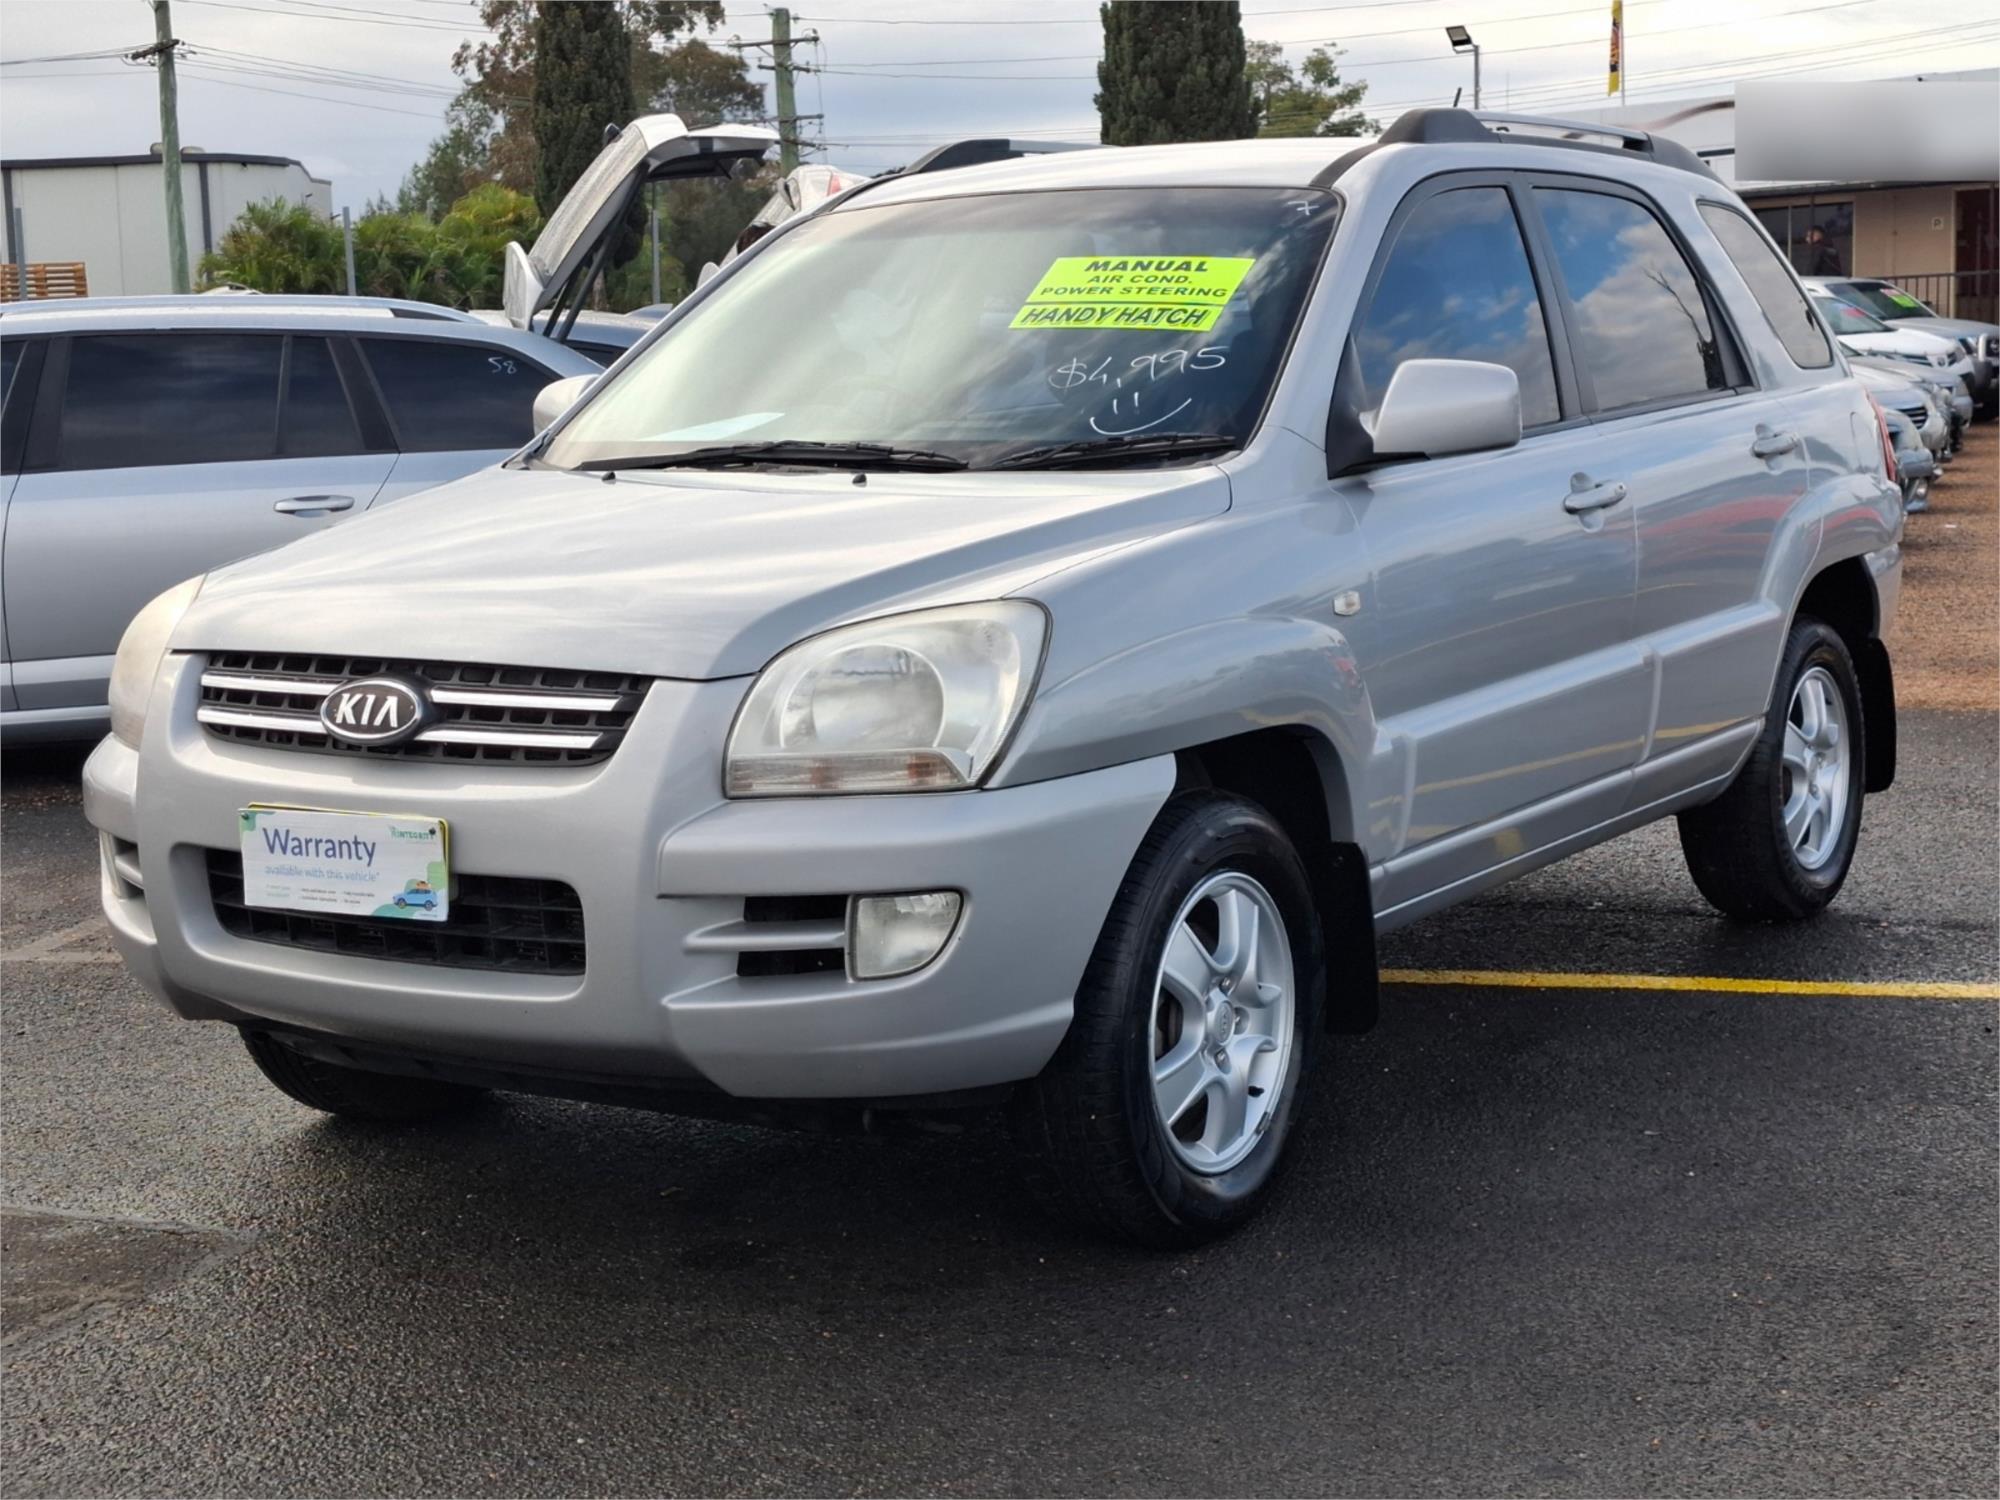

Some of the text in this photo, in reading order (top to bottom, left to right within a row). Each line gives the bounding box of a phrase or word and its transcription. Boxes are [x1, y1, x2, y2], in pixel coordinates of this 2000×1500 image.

[1286, 200, 1320, 216] 7
[1084, 260, 1208, 272] MANUAL
[1087, 274, 1193, 284] AIR COND.
[1040, 286, 1229, 298] POWER STEERING
[1020, 306, 1211, 326] HANDY HATCH
[488, 356, 518, 375] 58
[1048, 345, 1231, 394] $4,995
[335, 692, 399, 728] KIA
[262, 827, 376, 868] Warranty
